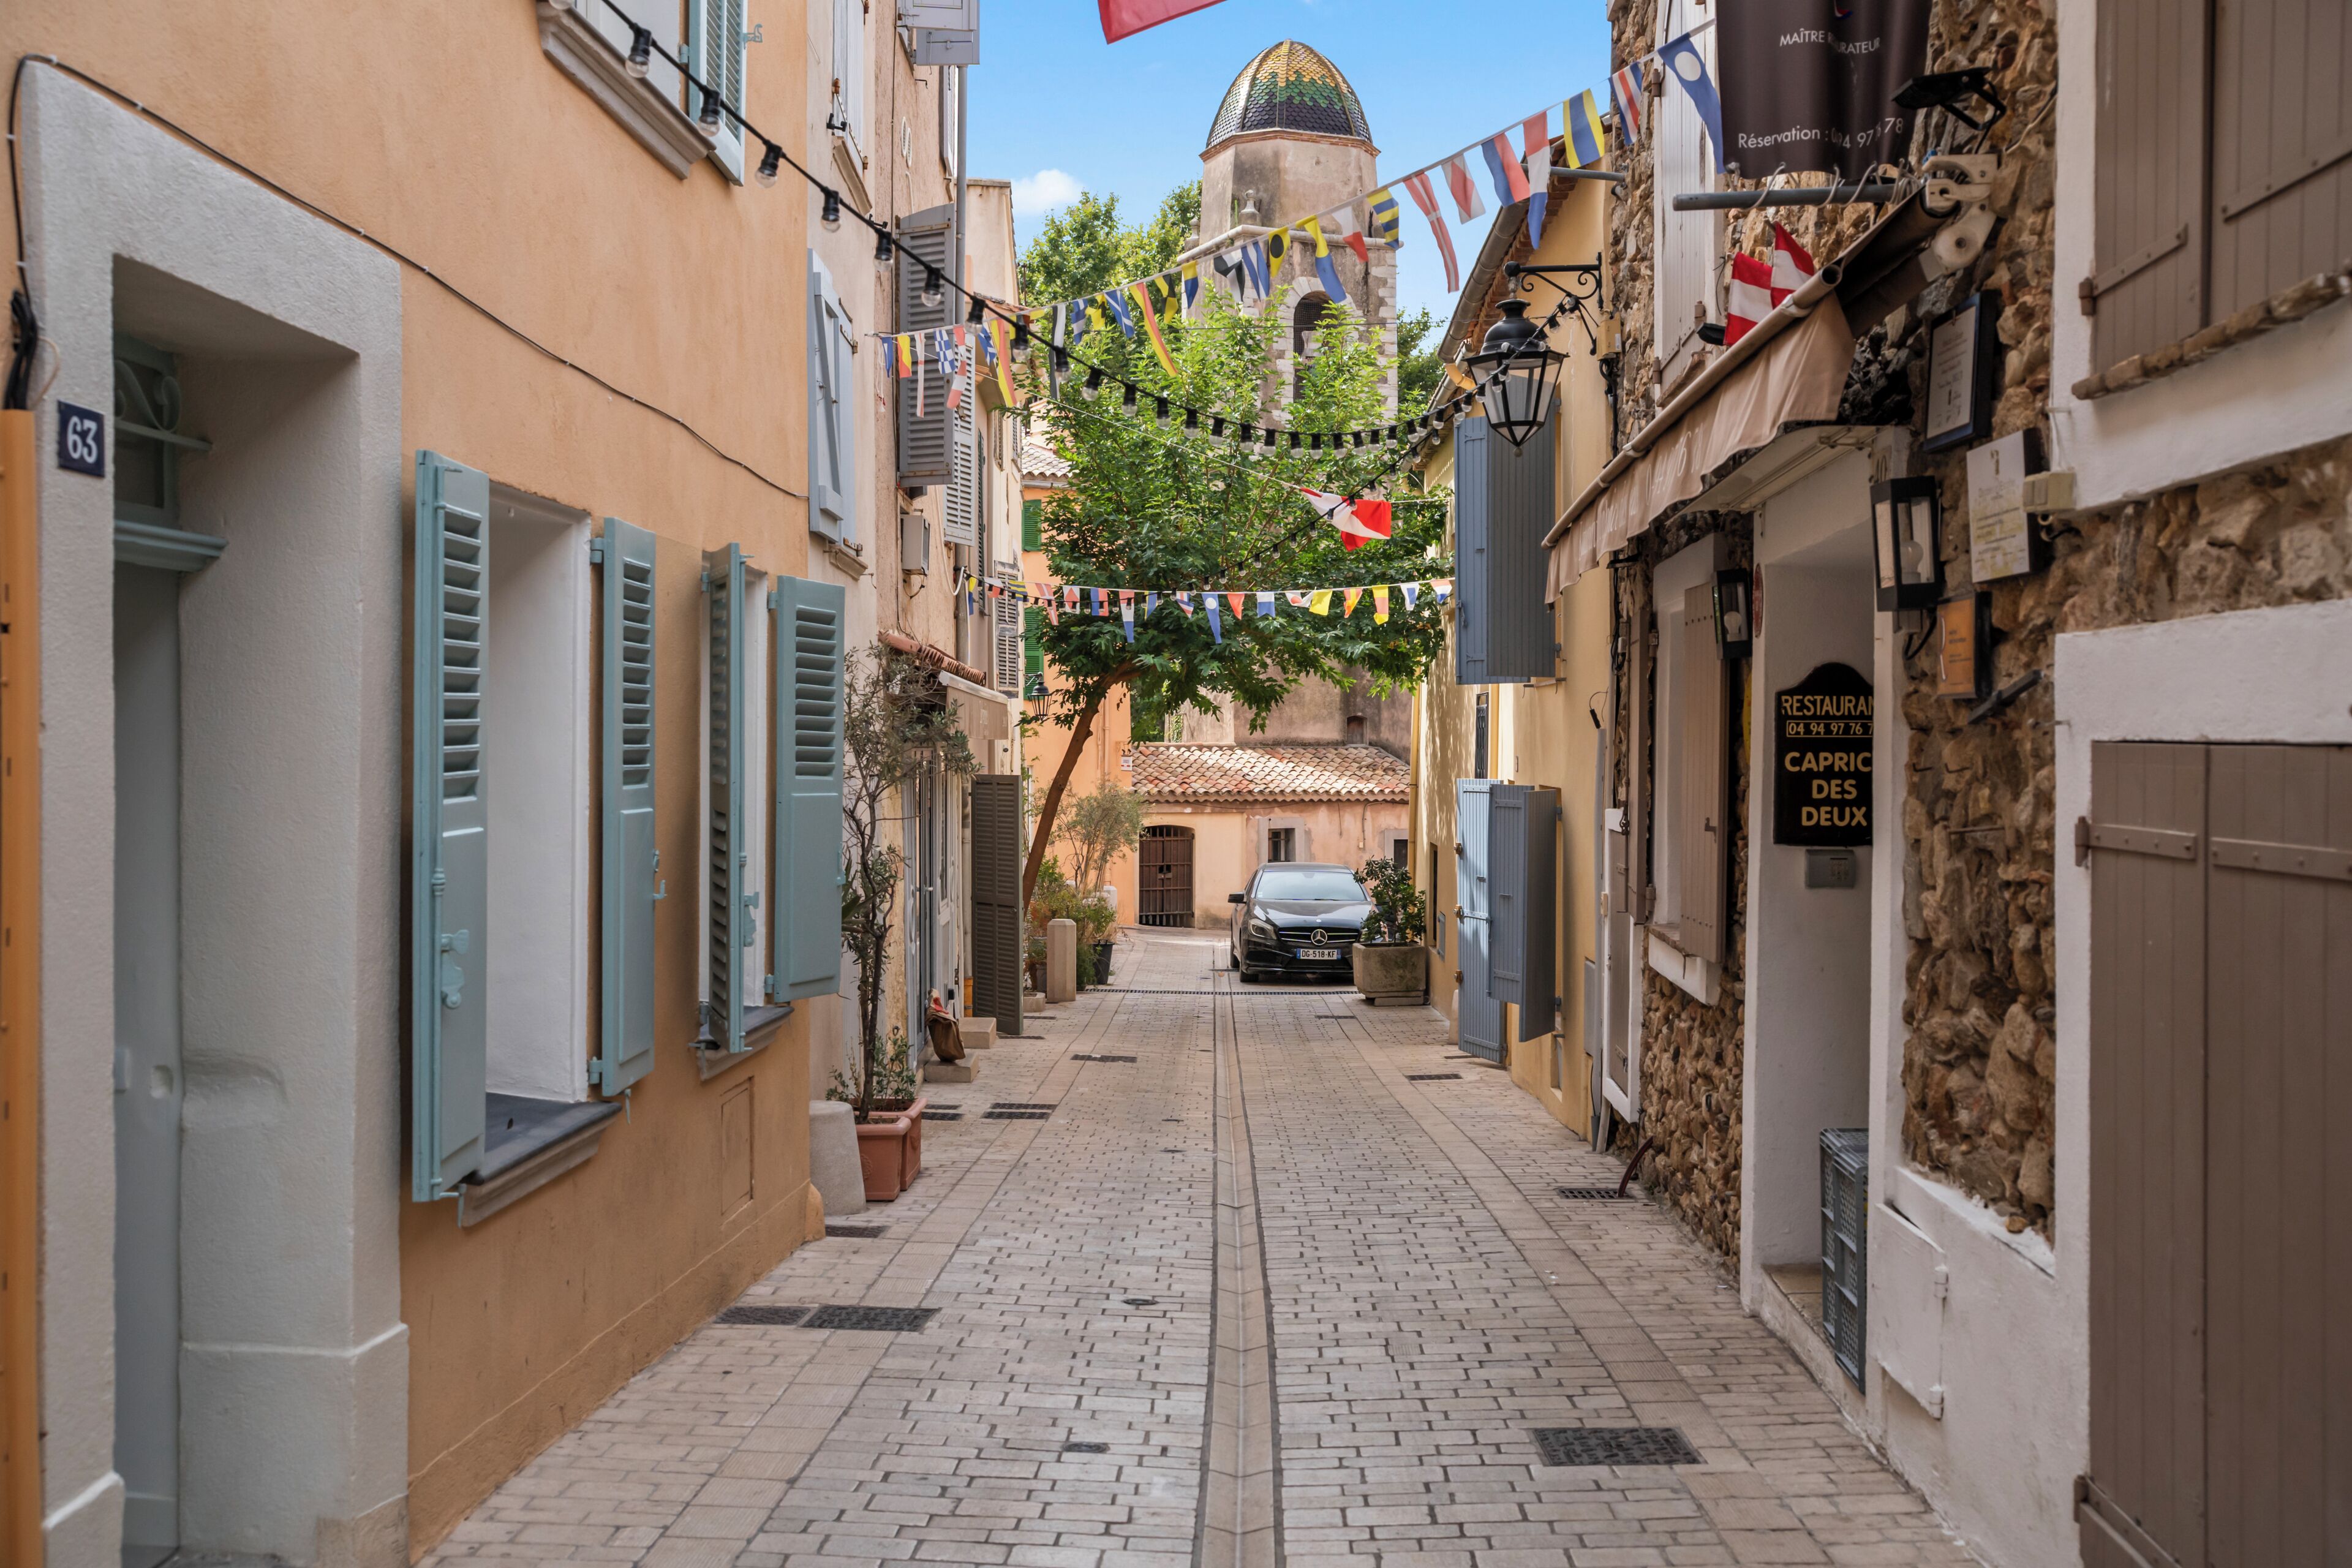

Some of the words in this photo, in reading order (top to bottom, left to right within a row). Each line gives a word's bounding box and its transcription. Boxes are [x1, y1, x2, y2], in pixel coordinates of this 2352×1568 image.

[1779, 28, 1825, 47] MAÎTRE
[1739, 126, 1820, 149] Réservation
[1856, 129, 1874, 149] 97
[1884, 117, 1904, 135] 78
[67, 415, 98, 464] 63
[1789, 723, 1804, 735] 04
[1810, 723, 1825, 735] 94
[1830, 723, 1845, 735] 97
[1849, 723, 1863, 735] 76
[1812, 779, 1858, 799] DES
[1801, 806, 1868, 827] DEUX
